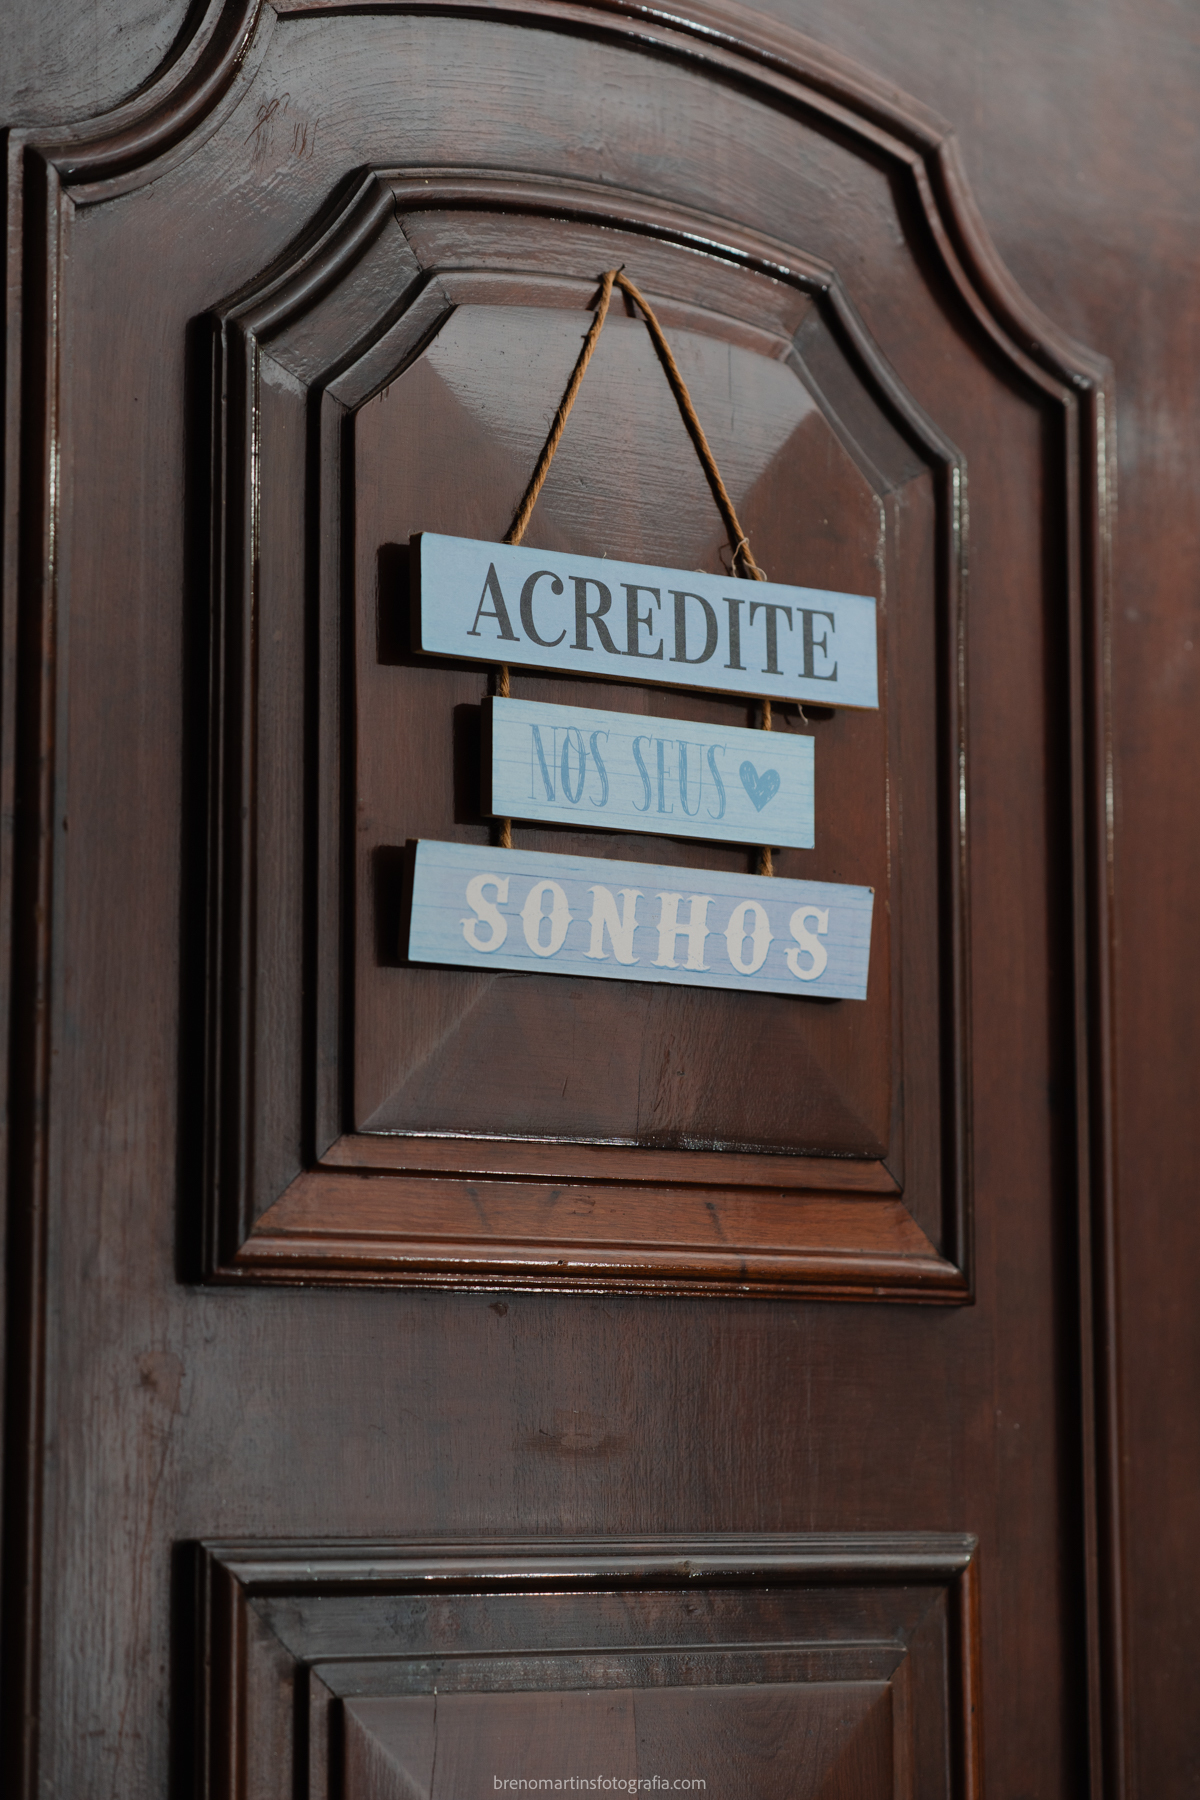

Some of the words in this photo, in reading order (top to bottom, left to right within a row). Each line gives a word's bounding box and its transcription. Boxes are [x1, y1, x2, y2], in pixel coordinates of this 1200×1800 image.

[467, 562, 838, 682] ACREDITE
[528, 724, 610, 807] NOS
[632, 734, 727, 819] SEUS
[460, 874, 830, 981] SONHOS
